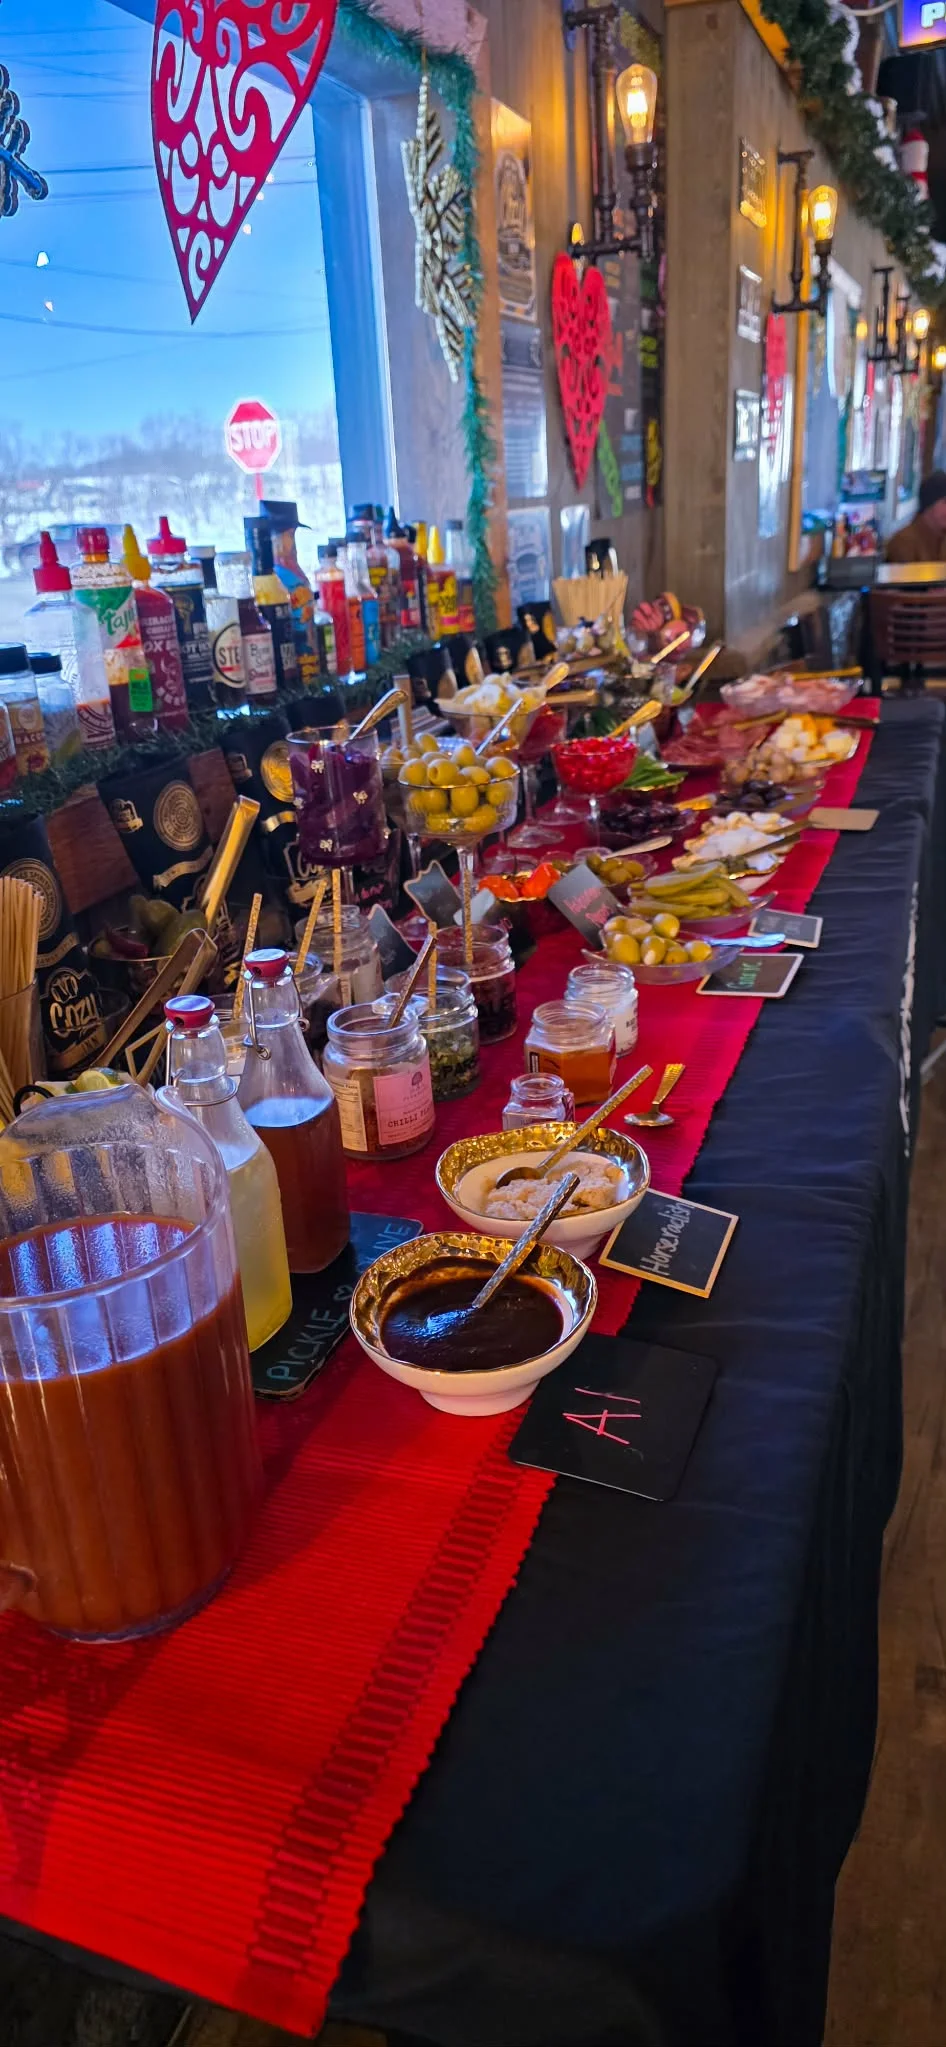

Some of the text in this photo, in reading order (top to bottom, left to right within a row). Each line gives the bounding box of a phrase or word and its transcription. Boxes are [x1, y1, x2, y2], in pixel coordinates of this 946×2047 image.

[230, 421, 275, 453] STOP
[388, 1113, 418, 1128] CHILLI
[640, 1201, 695, 1276] Horseradish
[266, 1308, 347, 1381] PICKLE
